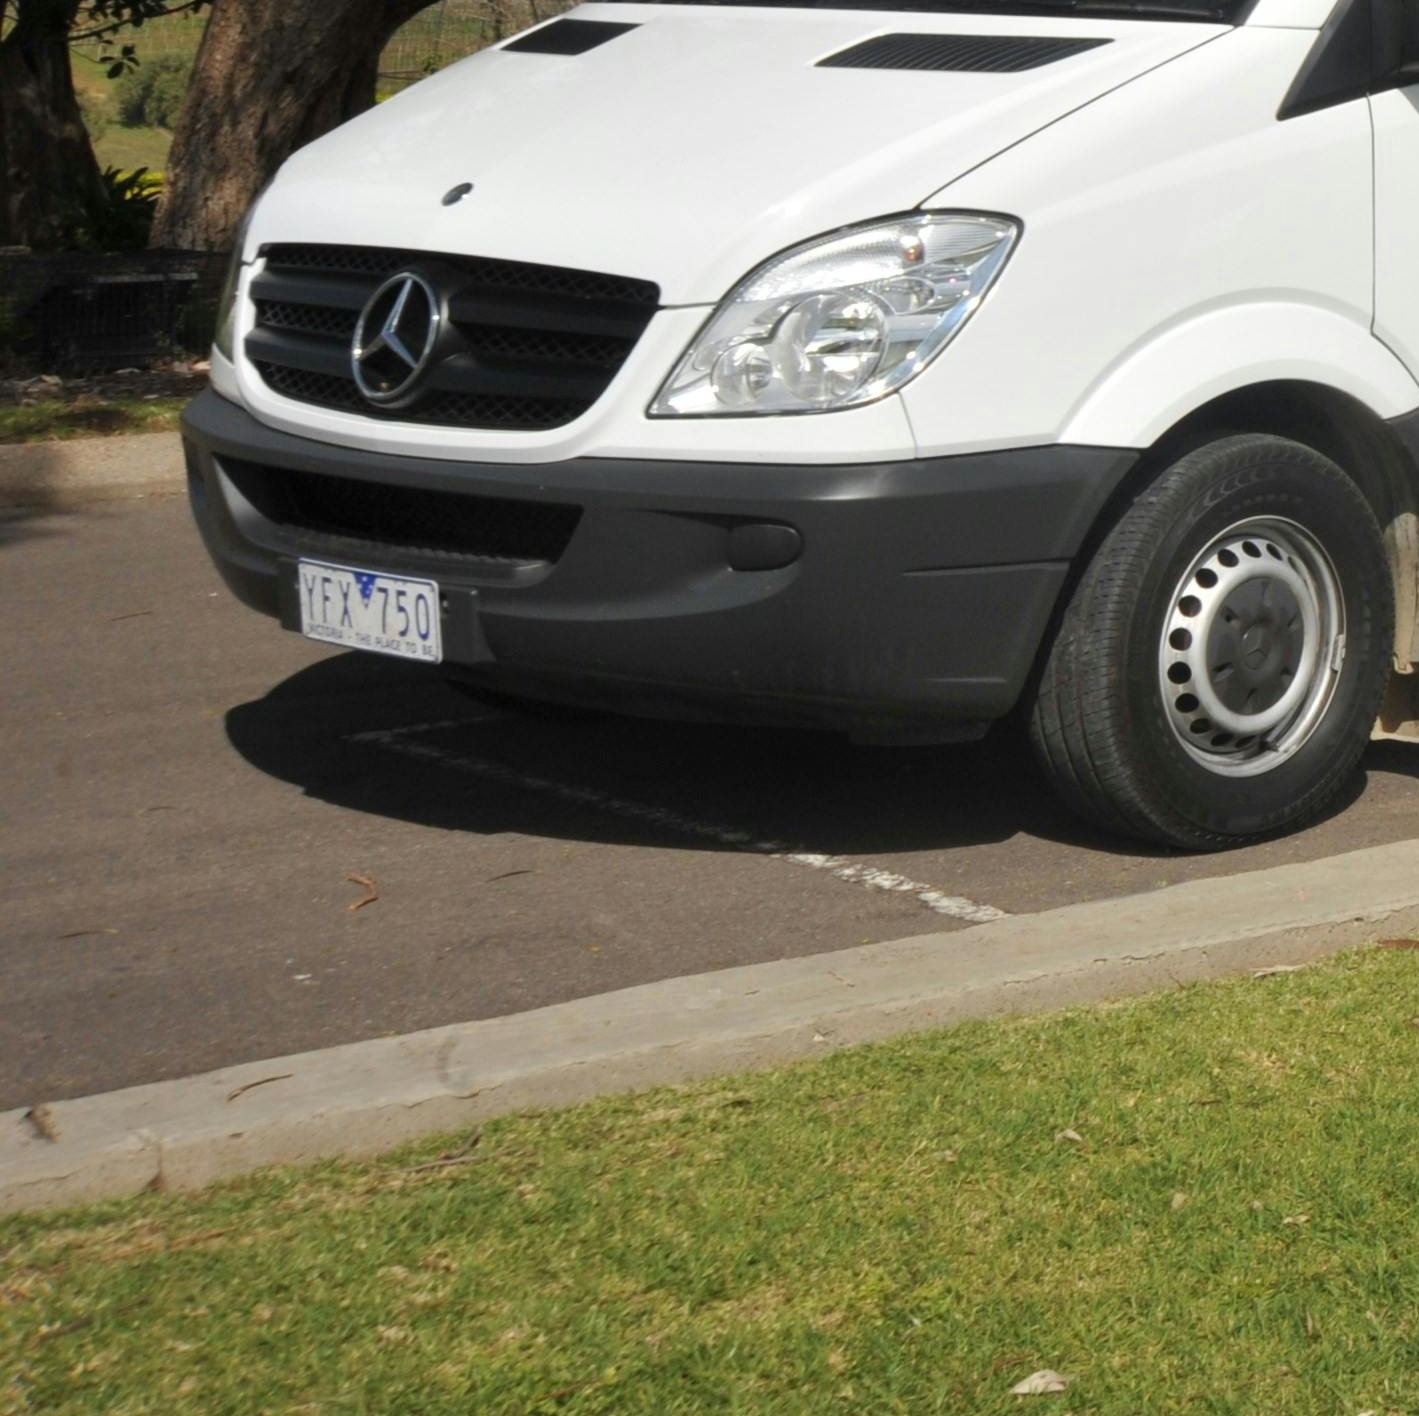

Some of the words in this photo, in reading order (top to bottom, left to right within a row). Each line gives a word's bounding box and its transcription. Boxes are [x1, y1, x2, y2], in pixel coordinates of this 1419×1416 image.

[303, 573, 353, 628] YFX
[376, 586, 430, 641] 750
[375, 636, 401, 651] PLACE
[405, 641, 417, 654] TO
[422, 645, 433, 657] BE
